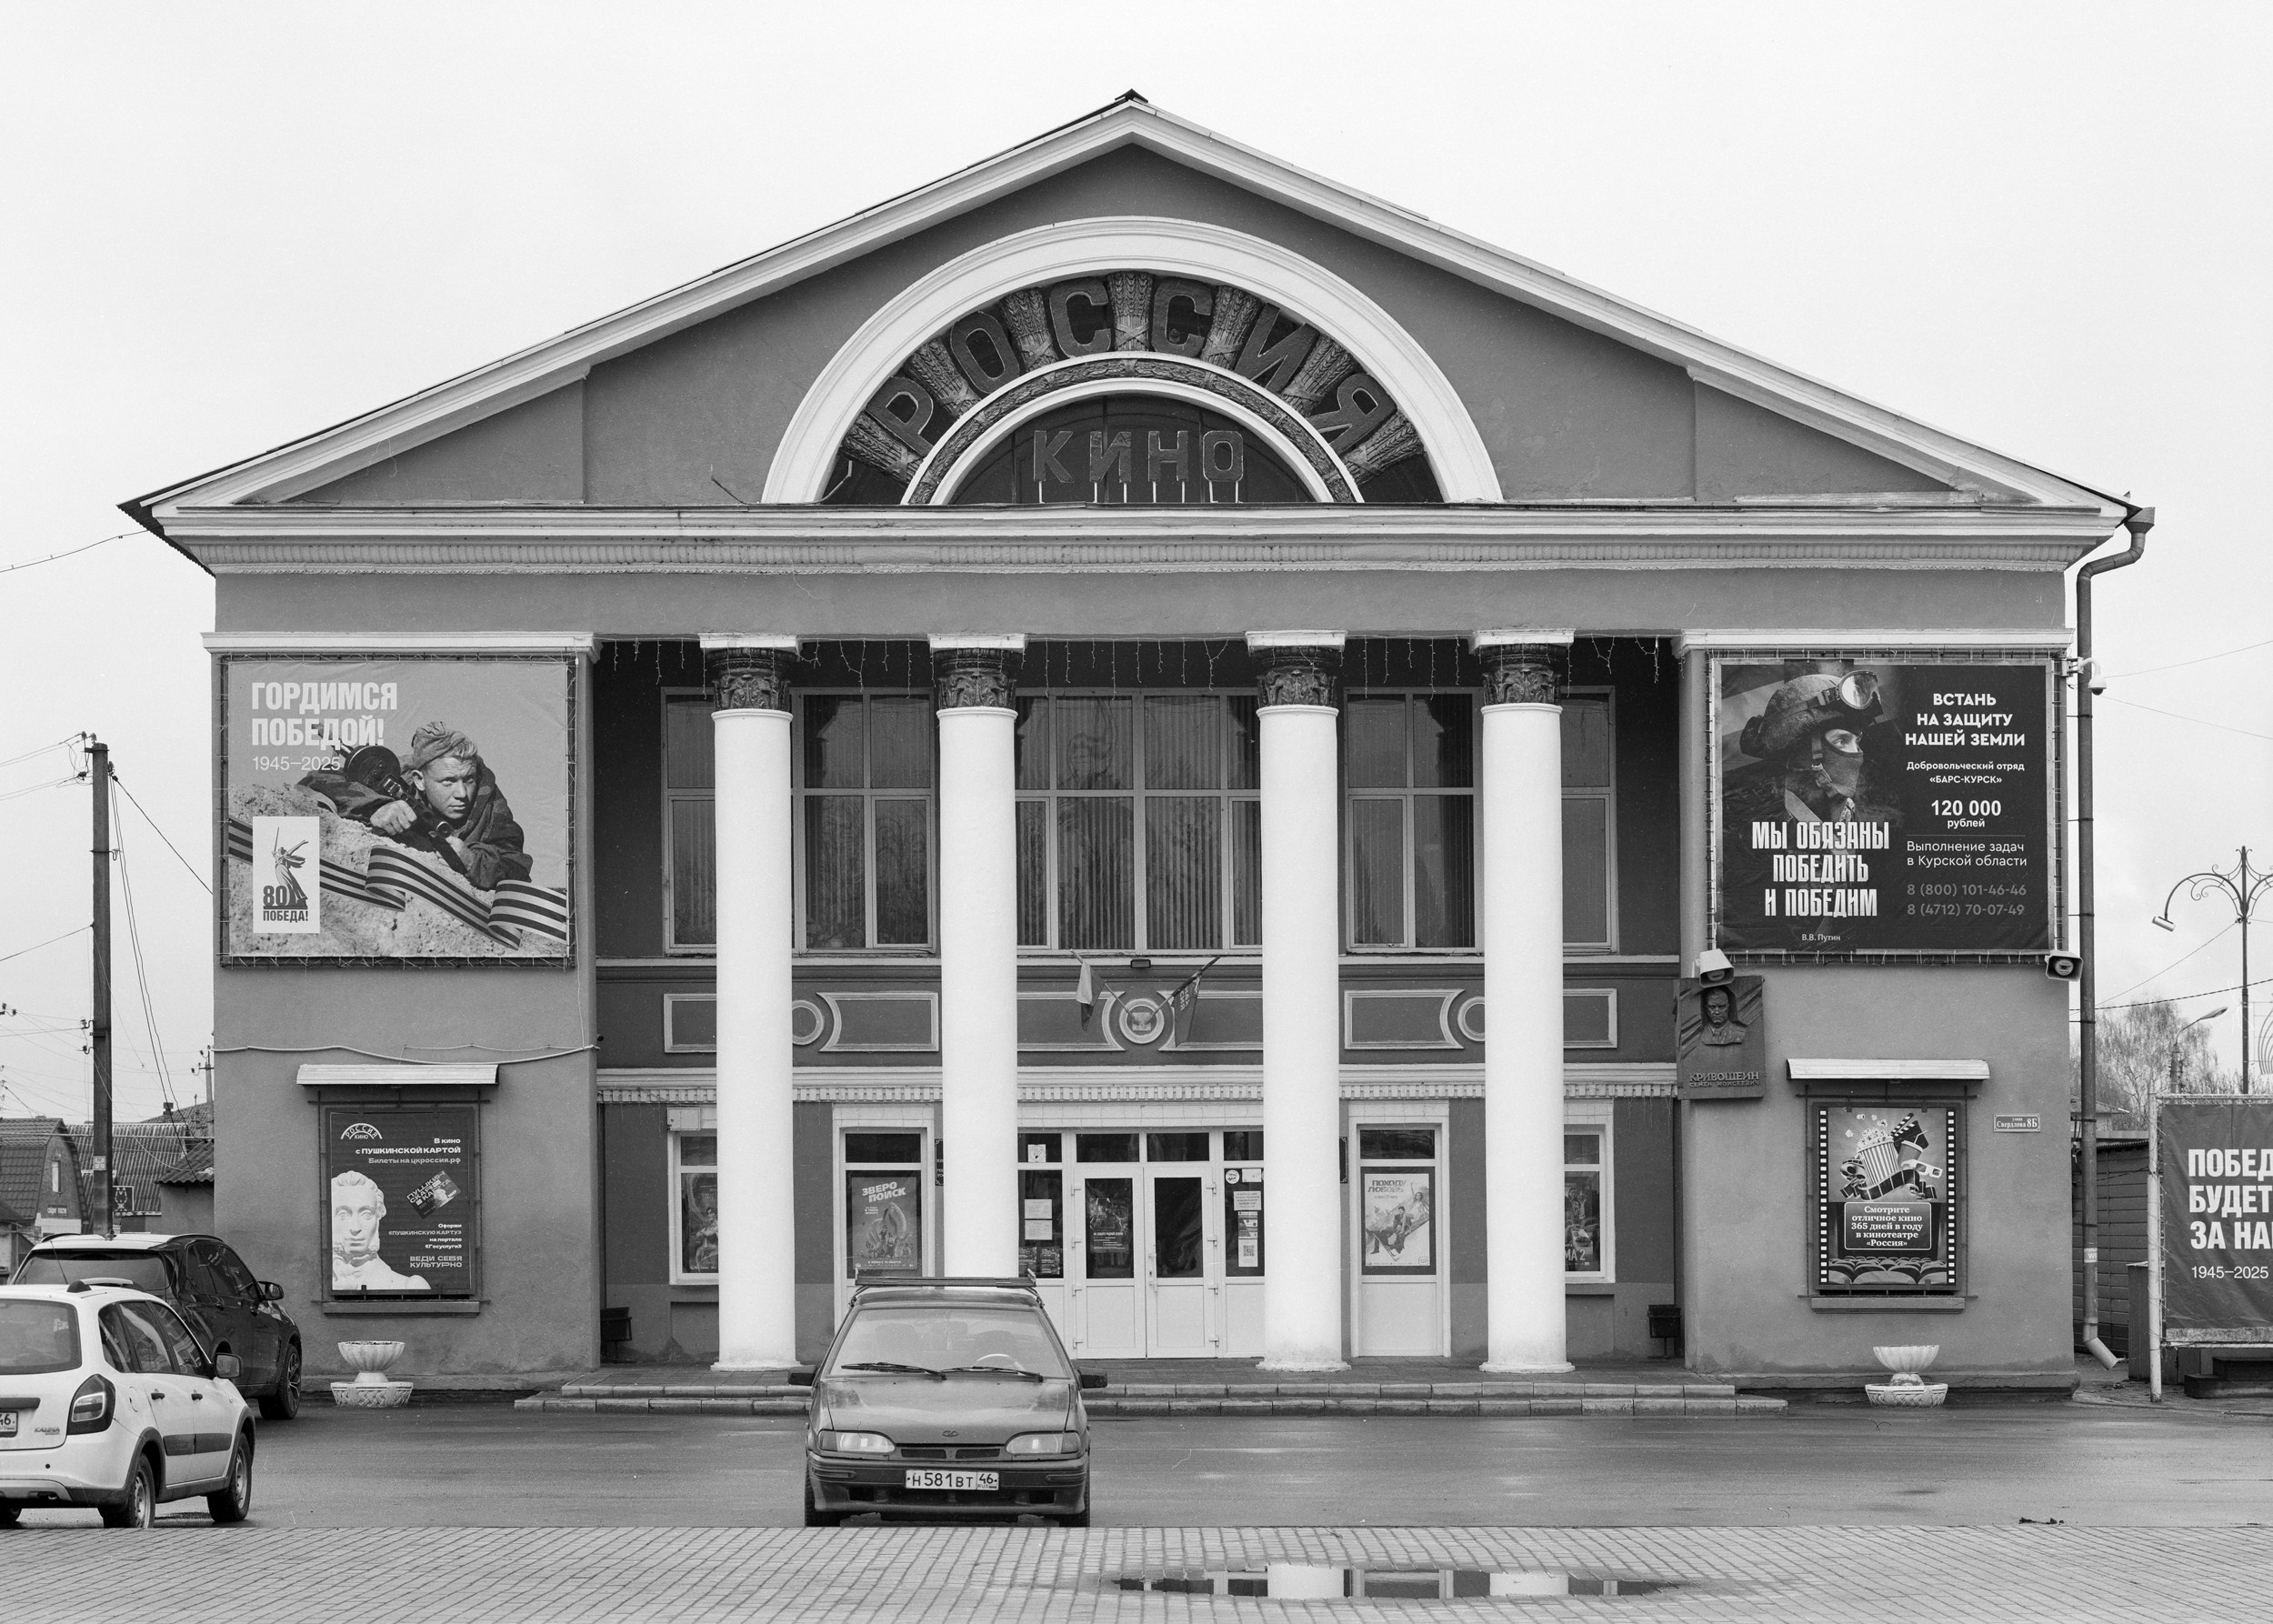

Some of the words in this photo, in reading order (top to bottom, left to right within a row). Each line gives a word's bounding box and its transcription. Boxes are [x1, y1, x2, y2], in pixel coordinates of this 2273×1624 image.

[870, 275, 1397, 456] РОССИЯ
[1033, 429, 1244, 483] КИНО
[252, 682, 397, 714] ГОРДИМСЯ
[1933, 693, 1997, 706] ВСТАНЬ
[1917, 713, 1939, 726] НА
[1943, 713, 2013, 728] ЗАЩИТУ
[252, 715, 385, 750] ПОБЕДОЙ!
[1905, 729, 1966, 746] НАШЕЙ
[1970, 733, 2026, 746] ЗЕМЛИ
[253, 756, 341, 771] 1945–2025
[1907, 761, 1994, 771] Добровольческий
[1997, 763, 2025, 771] отряд
[1929, 775, 2003, 784] «БАРС-КУРСК»
[1931, 799, 1963, 816] 120
[1968, 799, 2002, 817] 000
[1947, 818, 1986, 829] рублей
[1752, 821, 1787, 849] МЫ
[1797, 821, 1889, 849] ОБЯЗАНЫ
[1907, 840, 1986, 851] Выполнение
[1989, 843, 2025, 854] задач
[1907, 857, 1914, 866] в
[1918, 855, 1971, 868] Курской
[1976, 855, 2028, 867] области
[1773, 854, 1869, 884] ПОБЕДИТЬ
[263, 885, 288, 907] 80
[1907, 884, 1916, 896] 8
[1920, 883, 1958, 897] (800)
[1962, 884, 2027, 896] 101-46-46
[1765, 888, 1777, 917] И
[1785, 888, 1877, 917] ПОБЕДИМ
[263, 910, 309, 924] ПОБЕДА!
[1907, 904, 1916, 916] 8
[1920, 903, 1960, 917] (4712)
[1966, 904, 2025, 916] 70-07-49
[1817, 934, 1841, 943] Путин
[1690, 1072, 1759, 1081] КРИВОШЕИН
[345, 1125, 378, 1138] РОССИЯ
[362, 1147, 422, 1155] ПУШКИНСКОЙ
[862, 1181, 897, 1196] ЗВЕРО
[868, 1188, 906, 1203] ПОИСК
[2189, 1185, 2273, 1218] БУДЕТ
[1864, 1206, 1909, 1215] Смотрите
[1869, 1222, 1892, 1230] дней
[2190, 1221, 2226, 1249] ЗА
[2234, 1221, 2273, 1249] НА
[2191, 1266, 2268, 1278] 1945–2025
[979, 1474, 993, 1484] 46
